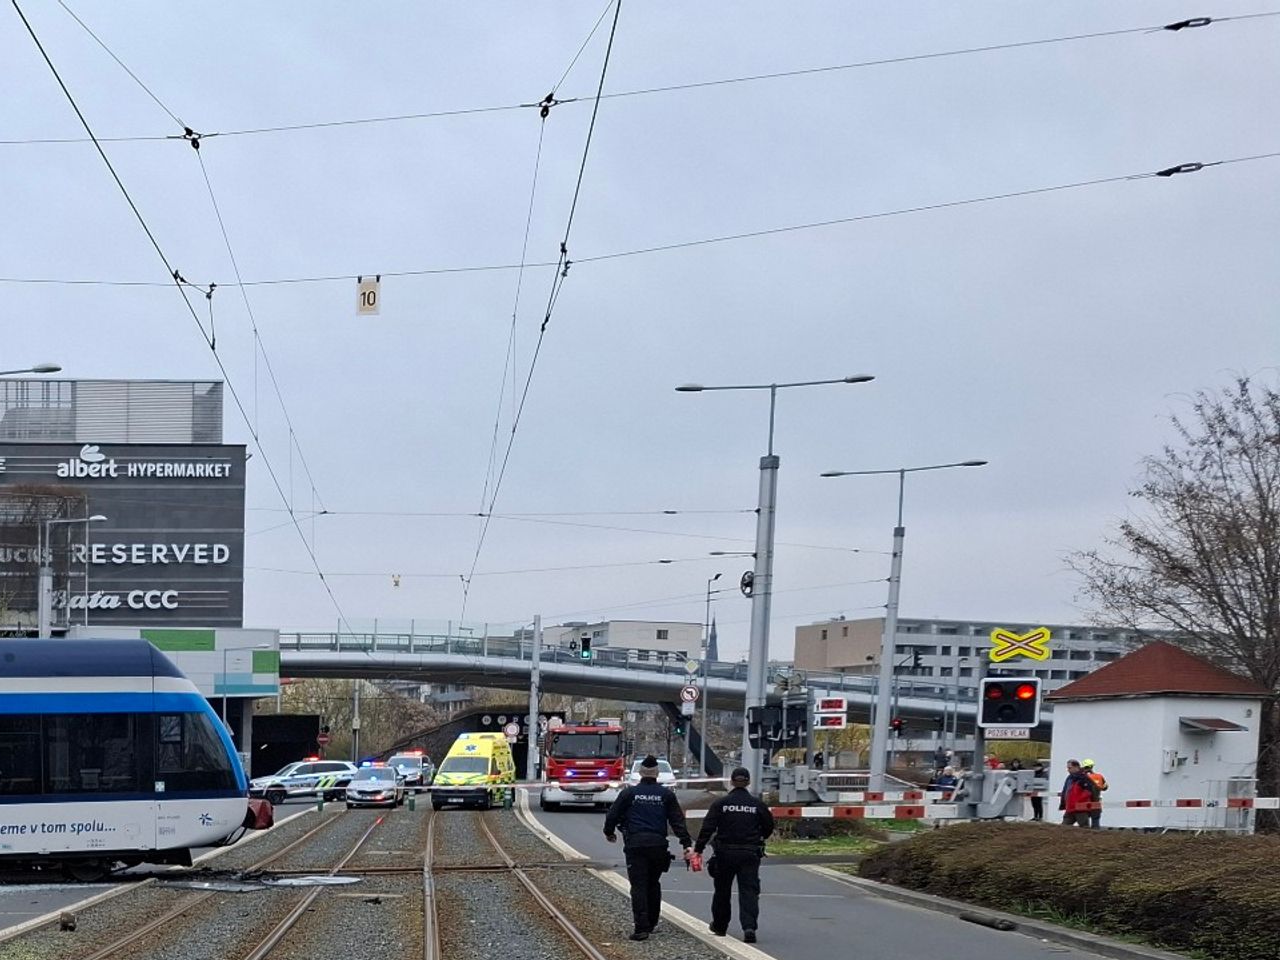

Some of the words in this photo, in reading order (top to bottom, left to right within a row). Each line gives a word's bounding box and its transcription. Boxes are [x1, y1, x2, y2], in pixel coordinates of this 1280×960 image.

[360, 290, 376, 307] 10
[57, 458, 118, 477] albert
[128, 463, 232, 477] HYPERMARKET
[71, 543, 230, 564] RESERVED
[127, 589, 179, 609] CCC
[634, 794, 662, 802] POLICIE
[722, 805, 757, 814] POLICIE
[30, 824, 38, 833] v
[41, 822, 67, 833] tom
[70, 820, 116, 836] spolu...
